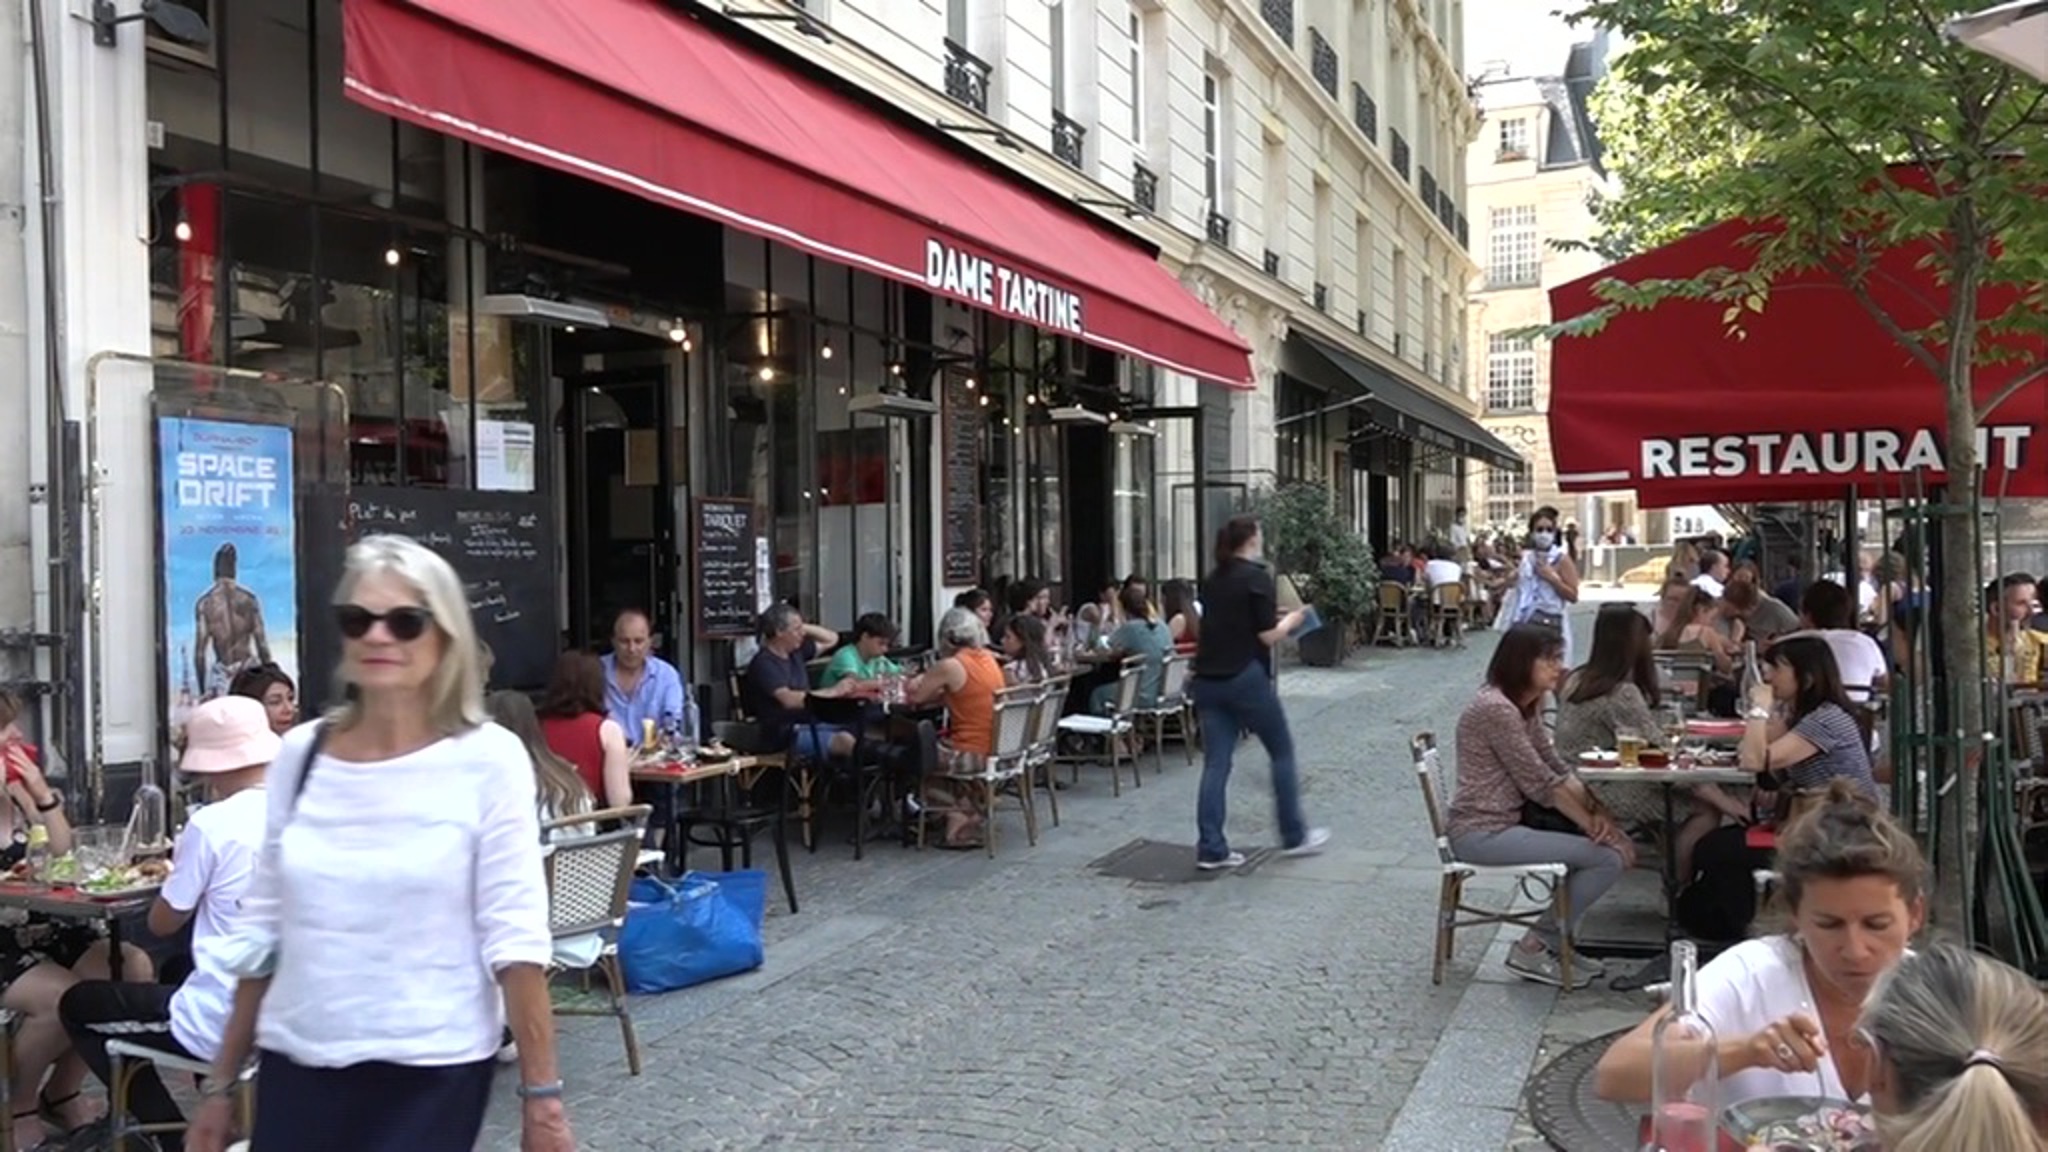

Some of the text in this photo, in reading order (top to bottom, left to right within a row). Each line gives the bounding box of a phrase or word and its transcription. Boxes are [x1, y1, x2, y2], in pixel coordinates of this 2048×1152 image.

[927, 239, 1082, 334] DAME TARTINE
[177, 452, 277, 479] SPACE
[179, 479, 276, 508] DRIFT
